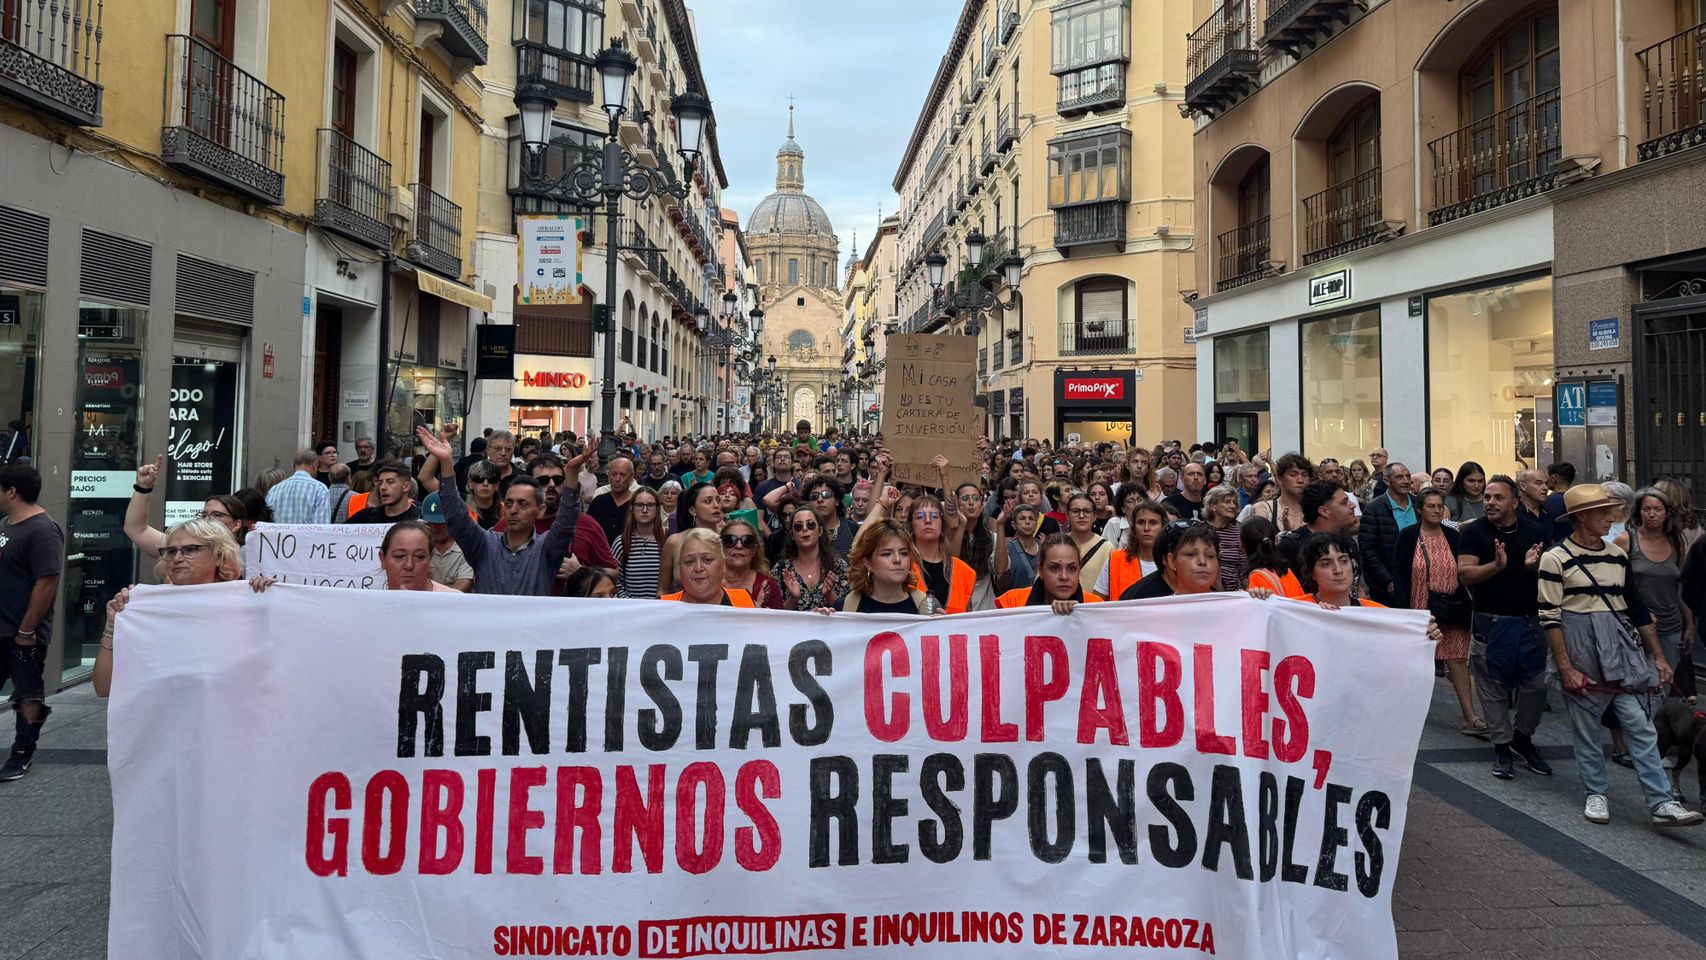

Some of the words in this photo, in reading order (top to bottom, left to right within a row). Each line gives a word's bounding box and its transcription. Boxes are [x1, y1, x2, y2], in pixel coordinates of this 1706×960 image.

[524, 371, 585, 388] MINISO
[929, 375, 957, 387] CASA
[170, 389, 203, 402] ODO
[169, 408, 200, 421] ARA
[896, 408, 940, 419] CARTERA
[946, 411, 960, 420] DE
[895, 423, 966, 435] INVERSIÓN
[74, 475, 107, 483] PRECIOS
[259, 532, 297, 563] NO
[309, 543, 337, 560] ME
[396, 642, 834, 758] RENTISTAS
[864, 632, 1332, 788] CULPABLES,
[304, 760, 783, 878] GOBIERNOS
[808, 751, 1391, 899] RESPONSABLES
[493, 924, 632, 957] SINDICATO
[646, 928, 682, 955] DE
[684, 918, 837, 954] INQUILINAS
[852, 916, 868, 947] E
[873, 911, 1024, 947] INQUILINOS
[1032, 912, 1068, 946] DE
[1072, 914, 1216, 956] ZARAGOZA
